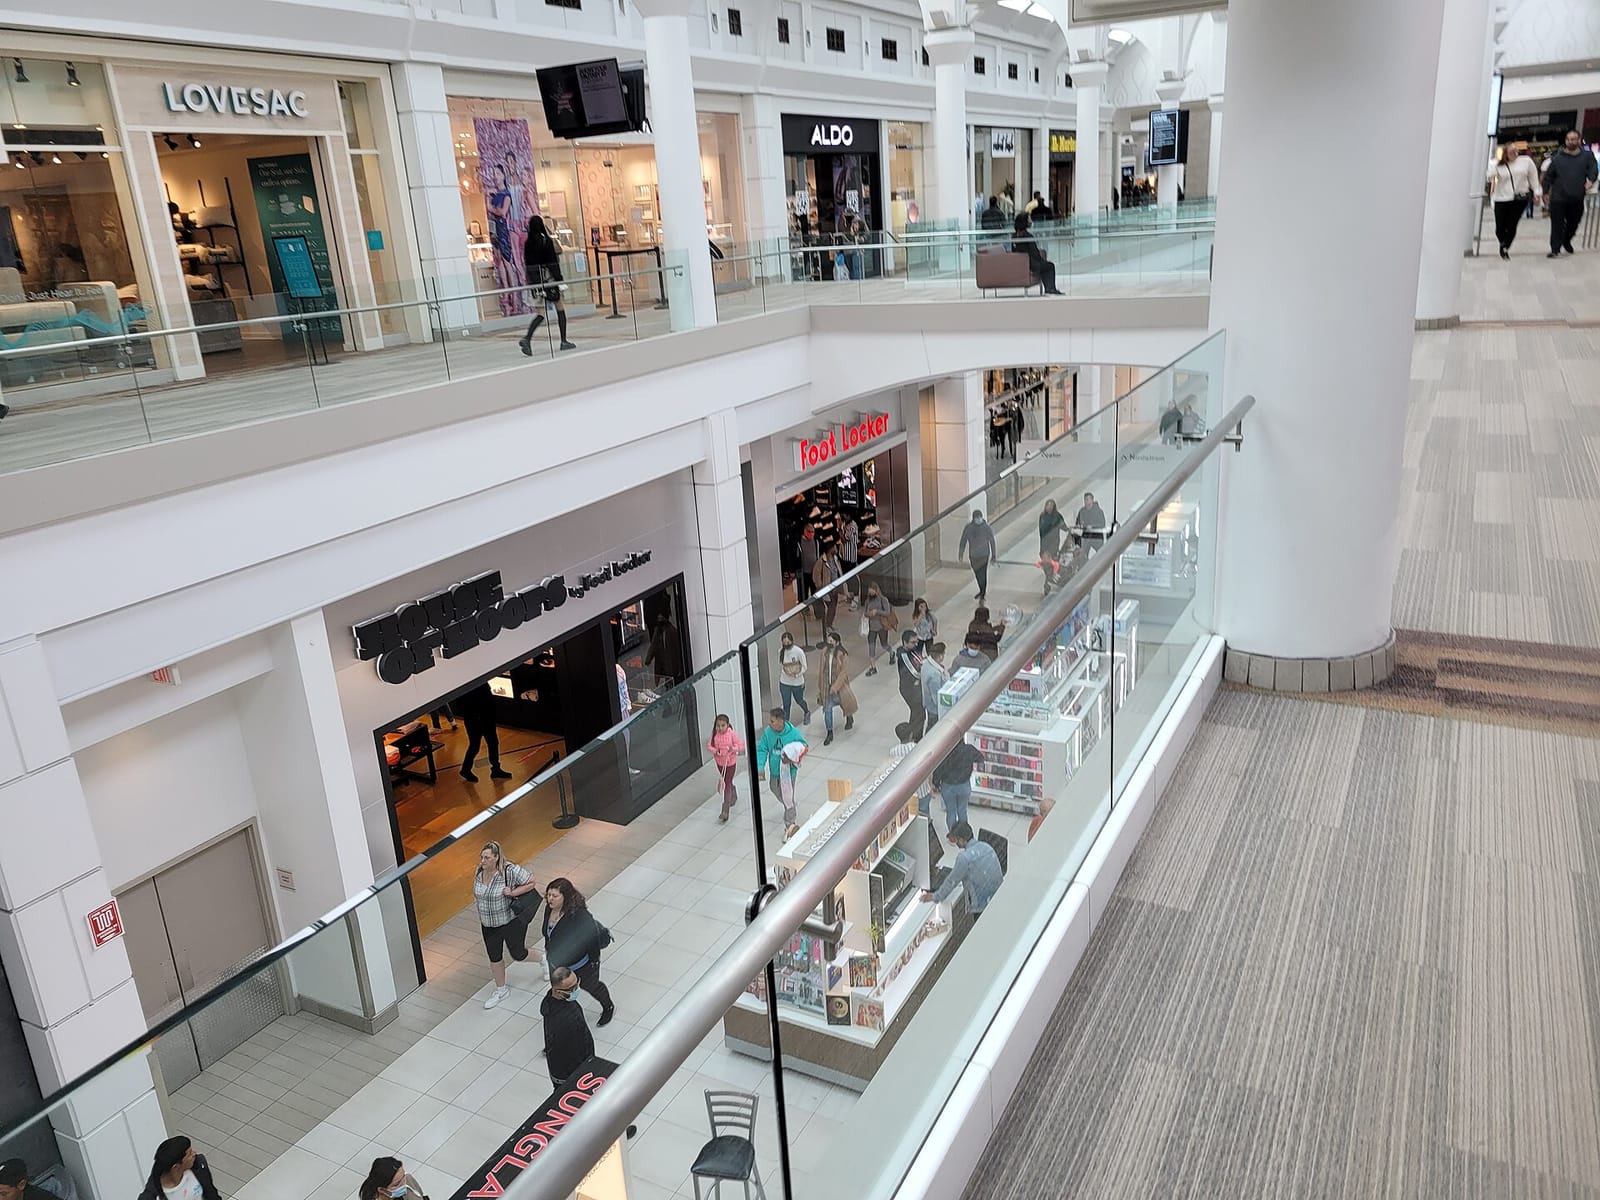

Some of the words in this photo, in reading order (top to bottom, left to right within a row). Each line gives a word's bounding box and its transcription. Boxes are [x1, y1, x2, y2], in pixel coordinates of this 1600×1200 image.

[163, 81, 309, 118] LOVESAC
[811, 124, 853, 146] ALDO
[800, 438, 837, 472] Foot
[841, 412, 889, 452] Locker
[581, 573, 613, 592] Foot
[609, 549, 653, 577] Locker
[353, 569, 504, 661] HOUSE
[376, 627, 437, 685] OF
[466, 1071, 608, 1200] SUNGLA
